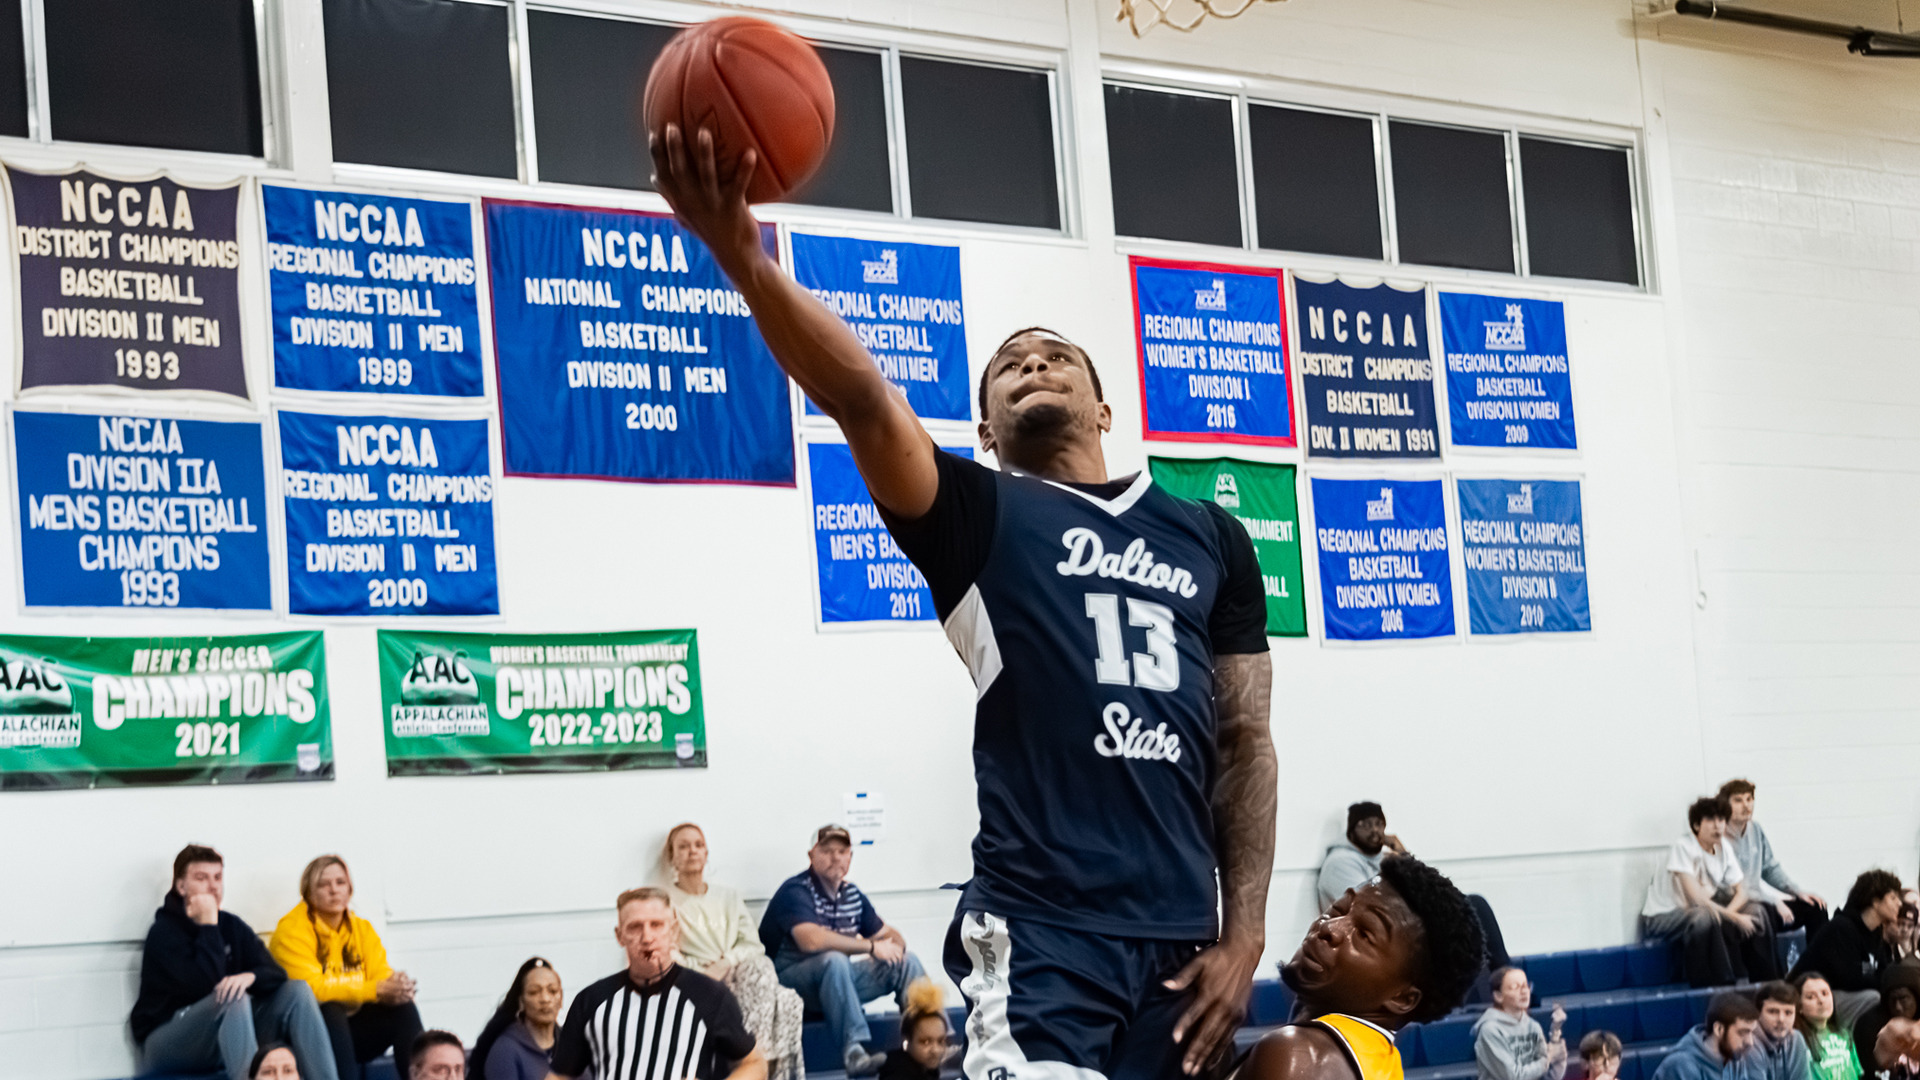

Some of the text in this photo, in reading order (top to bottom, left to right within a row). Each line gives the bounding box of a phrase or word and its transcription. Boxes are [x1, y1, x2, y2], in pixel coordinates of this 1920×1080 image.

[60, 180, 194, 231] NCCAA
[314, 200, 424, 247] NCCAA
[18, 226, 240, 269] DISTRICT CHAMPIONS
[582, 228, 688, 272] NCCAA
[268, 242, 475, 285] REGIONAL CHAMPIONS
[61, 267, 204, 305] BASKETBALL
[306, 282, 441, 317] BASKETBALL
[525, 278, 751, 318] NATIONAL CHAMPIONS
[811, 289, 962, 325] GIONAL CHAMPIONS
[42, 308, 220, 348] DIVISION II MEN
[291, 317, 463, 352] DIVISION II MEN
[580, 321, 708, 354] BASKETBALL
[850, 322, 932, 352] SKETBALL
[1145, 314, 1280, 346] REGIONAL CHAMPIONS
[1308, 306, 1417, 347] NCCAA
[1486, 326, 1524, 344] NCCAA
[115, 348, 180, 380] 1993
[358, 357, 412, 386] 1999
[1146, 344, 1283, 374] WOMEN'S BASKETBALL
[1300, 352, 1433, 382] DISTRICT CHAMPIONS
[1448, 353, 1568, 374] REGIONAL CHAMPIONS
[567, 361, 727, 393] DIVISION II MEN
[1189, 374, 1250, 400] DIVISION I
[1476, 378, 1546, 396] BASKETBALL
[626, 403, 678, 432] 2000
[1206, 404, 1236, 428] 2016
[1326, 390, 1414, 416] BASKETBALL
[1466, 401, 1513, 420] DIVISION
[1518, 402, 1560, 420] WOMEN
[99, 417, 183, 454] NCCAA
[336, 424, 438, 468] NCCAA
[1311, 425, 1436, 452] DIV. II WOMEN 1991
[1505, 424, 1529, 443] 2009
[68, 453, 221, 494] DIVISION IIA
[284, 468, 492, 504] REGIONAL CHAMPIONS
[30, 494, 257, 532] MENS BASKETBALL
[327, 508, 460, 538] BASKETBALL
[816, 503, 887, 530] REGIONA
[1236, 515, 1293, 542] RNAMENT
[1318, 527, 1446, 553] REGIONAL CHAMPIONS
[1464, 520, 1580, 546] REGIONAL CHAMPIONS
[79, 534, 220, 570] CHAMPIONS
[306, 544, 477, 572] DIVISION II MEN
[830, 533, 876, 560] MEN'S
[1465, 547, 1584, 572] WOMEN'S BASKETBALL
[1056, 527, 1198, 598] Dalton
[1349, 556, 1422, 581] BASKETBALL
[120, 570, 180, 606] 1993
[368, 578, 427, 607] 2000
[1336, 584, 1388, 608] DIVISION
[1395, 582, 1440, 607] WOMEN
[1502, 576, 1548, 599] DIVISION
[890, 592, 920, 618] 2011
[1381, 608, 1404, 632] 2006
[1520, 604, 1544, 628] 2010
[490, 644, 688, 664] WOMEN'S BASKETBALL TOURNAMENT
[1084, 593, 1180, 692] 13
[132, 645, 274, 674] MEN'S SOCCER
[410, 651, 469, 685] AAC
[92, 668, 317, 730] CHAMPIONS
[496, 663, 692, 720] CHAMPIONS
[2, 717, 80, 732] ALACHIAN
[395, 708, 487, 722] APPALACHIAN
[529, 712, 663, 746] 2022-2023
[175, 722, 241, 758] 2021
[1094, 702, 1181, 763] State
